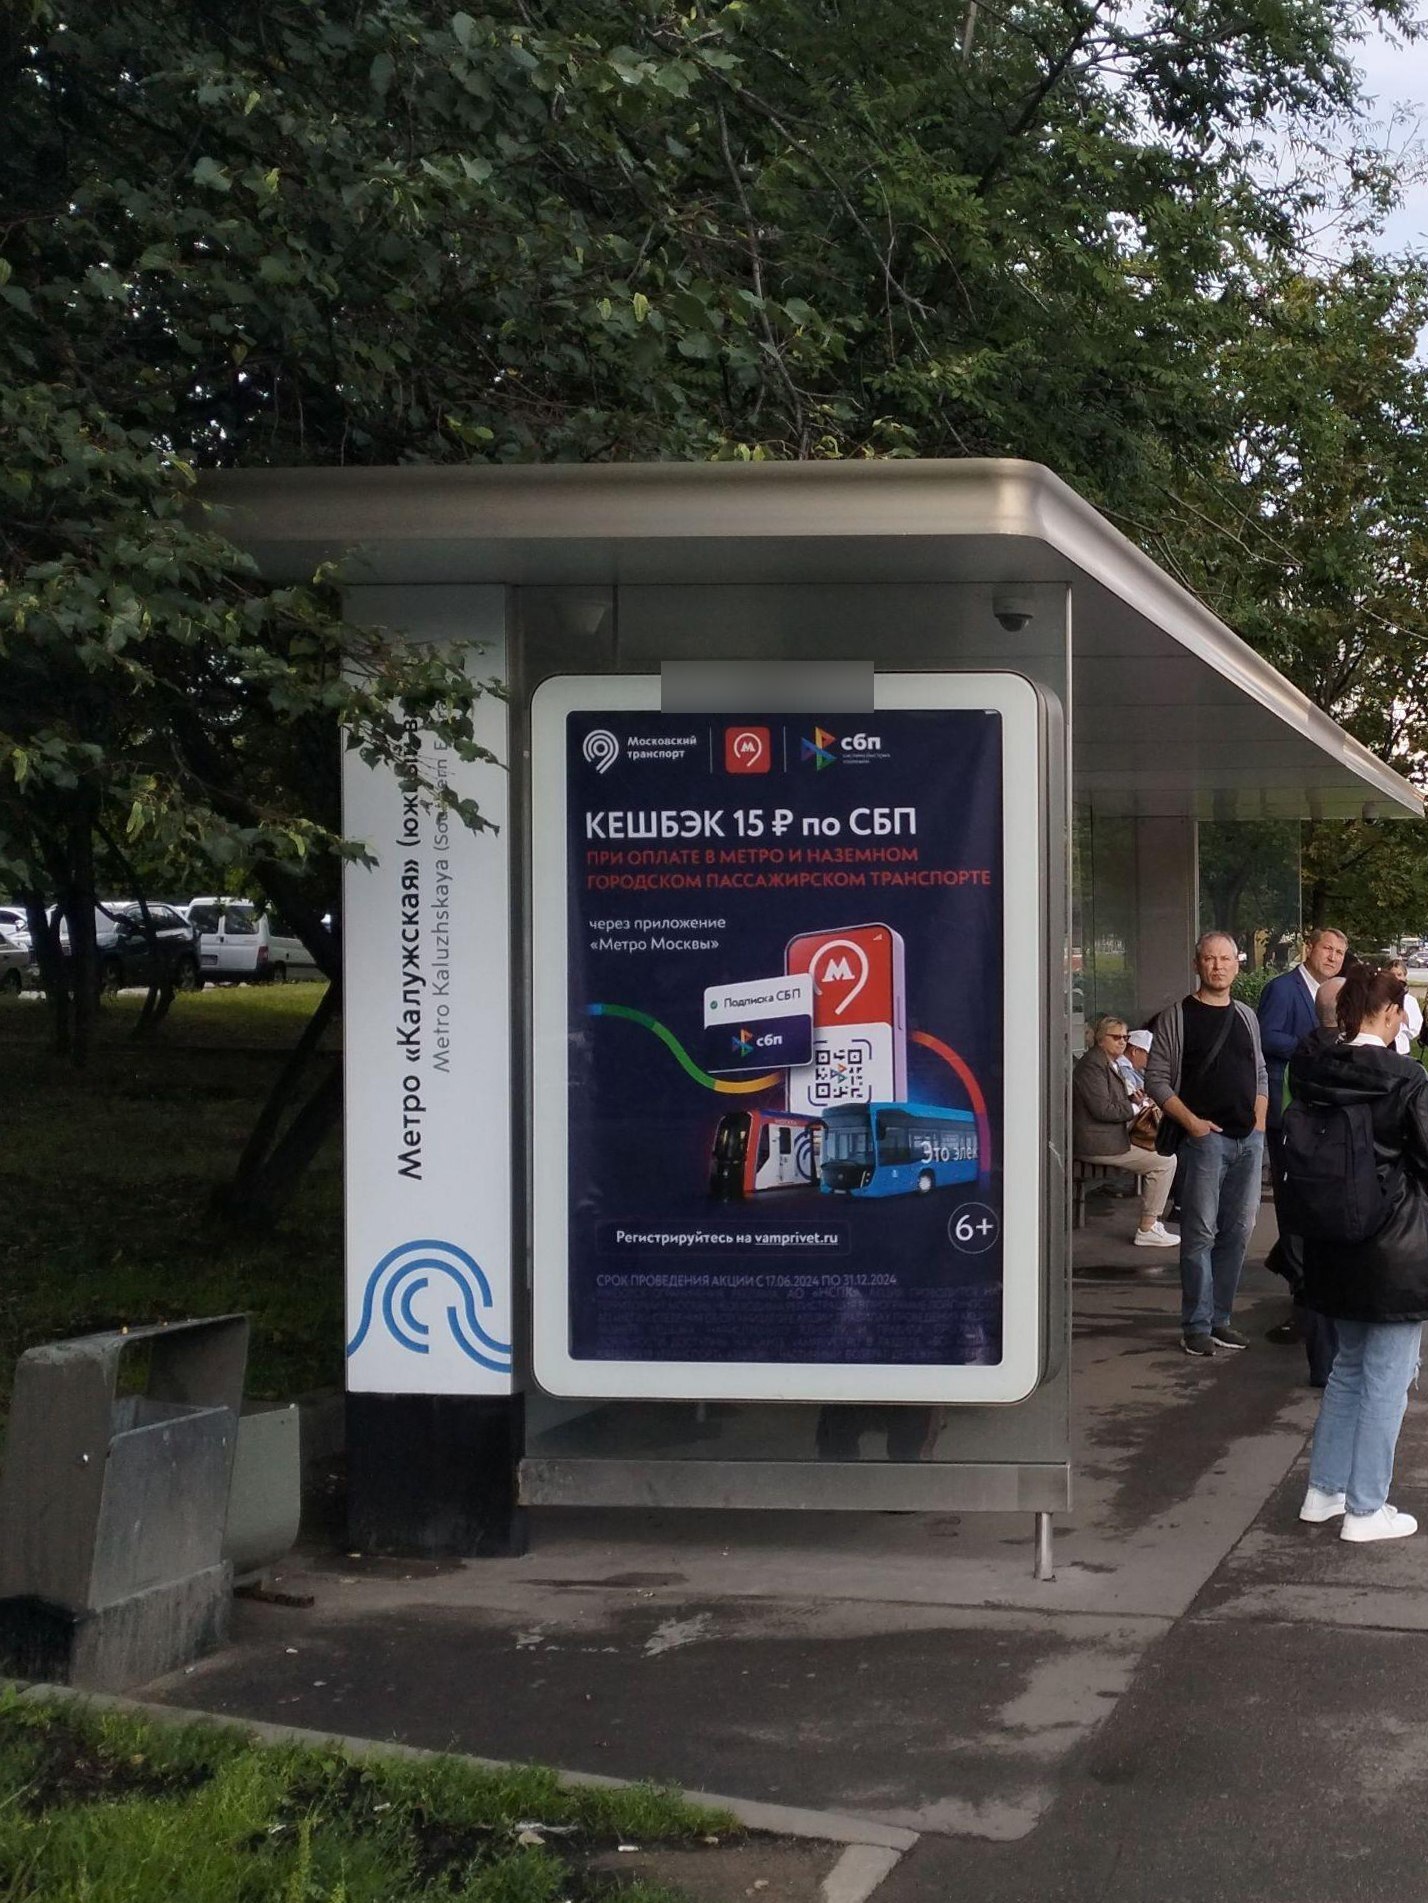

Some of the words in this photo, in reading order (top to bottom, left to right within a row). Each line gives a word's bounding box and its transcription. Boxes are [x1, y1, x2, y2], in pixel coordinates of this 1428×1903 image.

[627, 735, 697, 747] Московский
[840, 732, 881, 750] сбп
[627, 749, 685, 760] транспорт
[432, 758, 451, 852] (Souern
[585, 809, 725, 839] КЕШБЭК
[733, 809, 764, 837] 15
[802, 817, 841, 836] по
[849, 807, 917, 836] СБП
[587, 850, 624, 865] ПРИ
[627, 849, 700, 865] ОПЛАТЕ
[705, 849, 716, 864] В
[722, 848, 785, 864] МЕТРО
[788, 848, 802, 863] И
[806, 847, 919, 863] НАЗЕМНОМ
[587, 873, 702, 891] ГОРОДСКОМ
[706, 871, 866, 888] ПАССАЖИРСКОМ
[870, 868, 991, 886] ТРАНСПОРТЕ
[431, 859, 454, 996] Kaluzhskaya
[589, 919, 631, 932] через
[634, 917, 726, 930] приложение
[590, 937, 647, 953] «Метро
[650, 936, 720, 951] Москвы»
[396, 858, 427, 1063] «Калужская»
[723, 995, 775, 1008] Подписка
[775, 987, 801, 1002] СБП
[432, 1004, 450, 1073] Metro
[756, 1033, 783, 1047] сбп
[397, 1075, 427, 1181] Метро
[920, 1140, 950, 1164] Это
[616, 1229, 733, 1246] Регистрируйтесь
[736, 1233, 752, 1244] на
[755, 1231, 839, 1246] vamprivet.ru
[955, 1214, 993, 1240] 6+
[596, 1274, 629, 1287] СРОК
[631, 1274, 709, 1288] ПРОВЕДЕНИЯ
[711, 1274, 754, 1288] АКЦИИ
[756, 1274, 764, 1287] С
[766, 1273, 820, 1287] 17.06.2024
[822, 1273, 841, 1286] ПО
[843, 1273, 897, 1286] 31.12.2024
